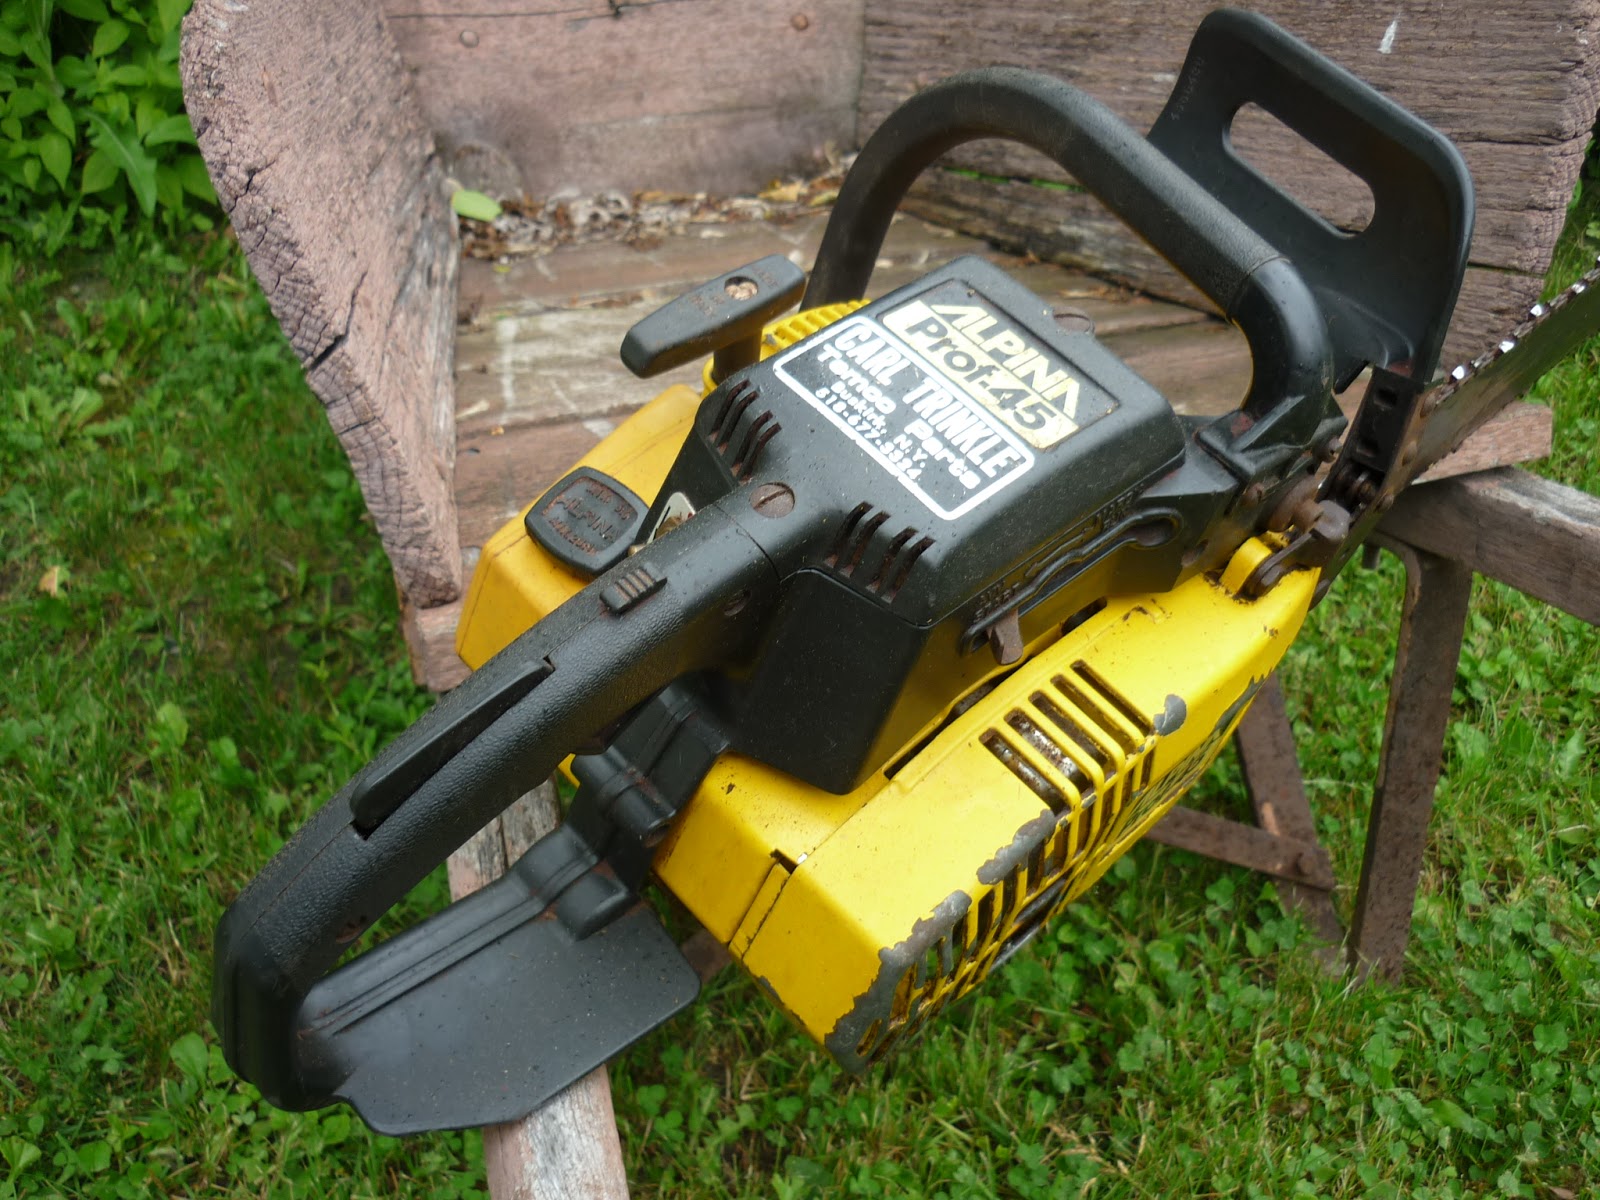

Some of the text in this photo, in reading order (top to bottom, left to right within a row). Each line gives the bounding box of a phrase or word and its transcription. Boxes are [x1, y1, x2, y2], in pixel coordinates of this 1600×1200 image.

[835, 324, 1022, 478] CARL TRINKLE
[930, 304, 1080, 419] ALPINA
[904, 418, 981, 489] Parts
